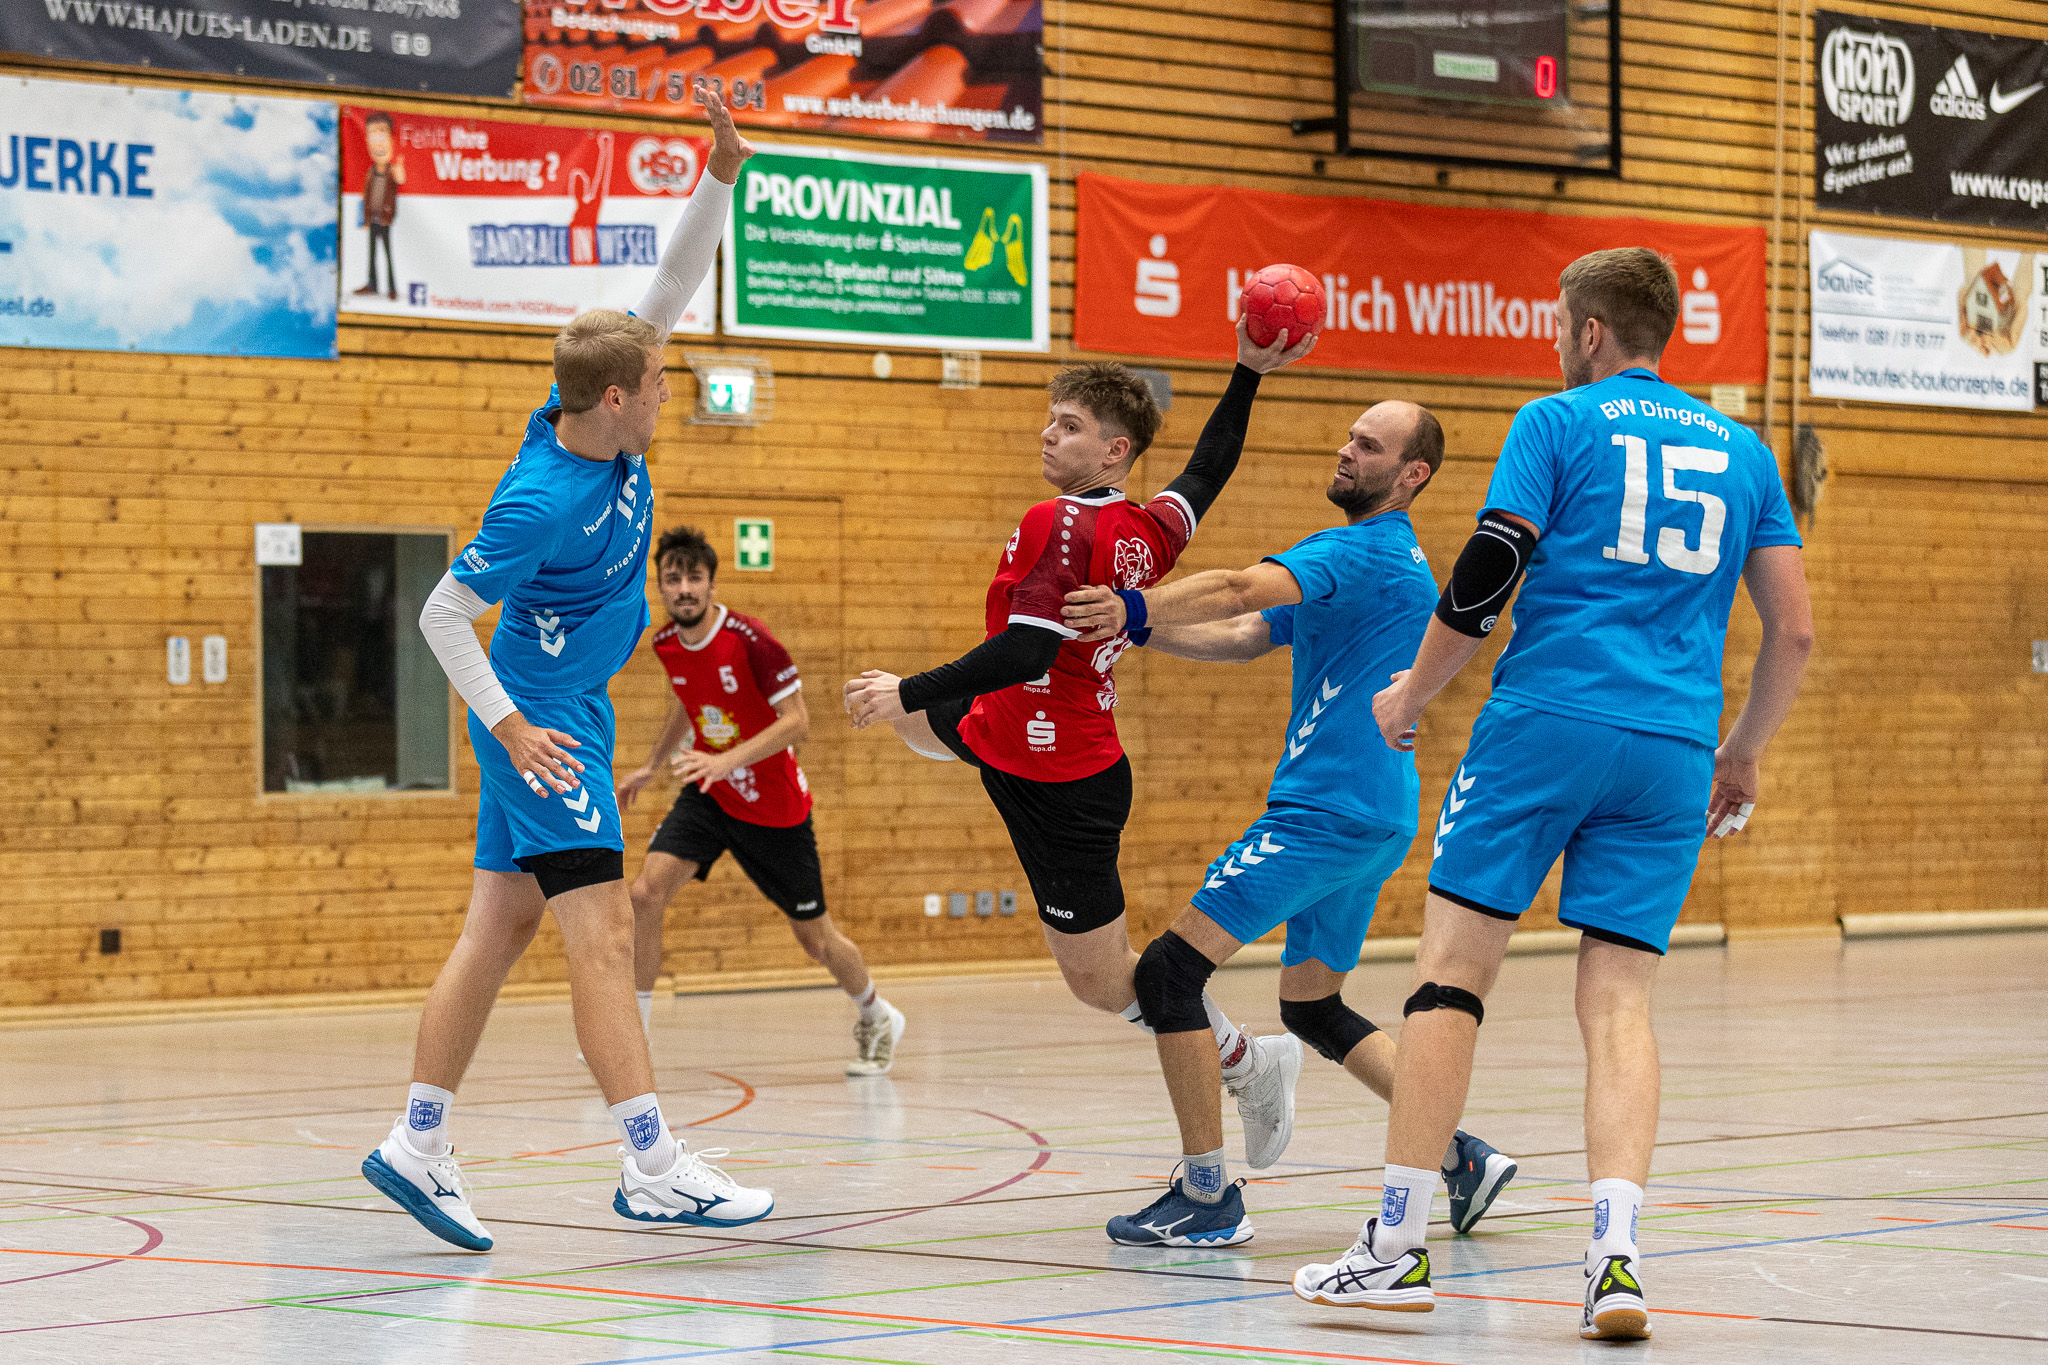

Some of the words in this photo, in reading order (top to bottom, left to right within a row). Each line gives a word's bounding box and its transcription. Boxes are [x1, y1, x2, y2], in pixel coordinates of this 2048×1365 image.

[551, 8, 680, 40] Bedachungen
[805, 33, 863, 57] GmbH
[569, 62, 603, 95] 02
[610, 64, 641, 100] 81
[667, 71, 685, 103] 5
[731, 77, 765, 111] 94
[1535, 55, 1557, 99] 0
[783, 93, 1036, 132] www.weberbedachungen.de
[1837, 91, 1899, 127] SPORT
[1929, 93, 1987, 121] adidas
[450, 127, 489, 151] Ihre
[1824, 141, 1857, 167] Wir
[1858, 133, 1907, 161] ziehen
[1823, 160, 1887, 195] Sportler
[745, 170, 962, 230] PROVINZIAL
[470, 225, 569, 267] HANDBALL
[571, 227, 598, 266] IN
[598, 226, 657, 266] WESEL
[745, 223, 768, 242] Die
[769, 226, 853, 252] Versicherung
[854, 232, 878, 250] der
[896, 234, 963, 255] Sparkassen
[892, 266, 921, 284] und
[922, 266, 965, 287] Söhne
[1813, 365, 2029, 397] www.bautec-baukonzepte.de
[1600, 399, 1636, 421] BW
[1640, 399, 1730, 441] Dingden
[583, 502, 613, 536] hummel
[1602, 434, 1729, 575] 15
[718, 665, 738, 694] 5
[1023, 685, 1051, 694] nispa.de
[1046, 905, 1074, 919] JAKO
